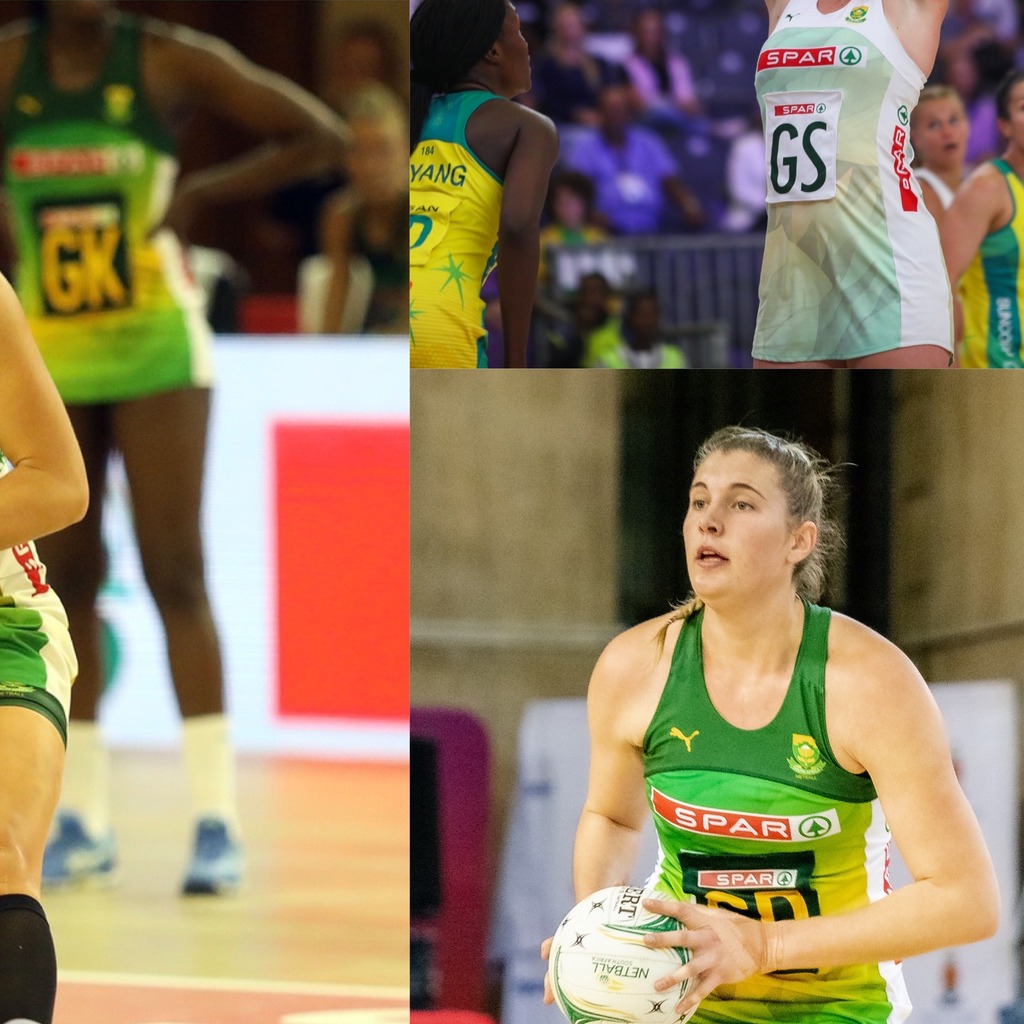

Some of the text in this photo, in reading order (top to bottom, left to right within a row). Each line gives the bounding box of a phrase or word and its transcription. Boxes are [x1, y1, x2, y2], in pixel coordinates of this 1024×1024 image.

[766, 49, 834, 65] SPAR
[782, 105, 814, 115] SPAR
[421, 146, 435, 156] 184
[770, 121, 827, 195] GS
[410, 163, 467, 188] YANG
[41, 226, 125, 311] GK
[675, 807, 789, 838] SPAR
[716, 873, 773, 886] SPAR
[591, 962, 650, 979] NETBALL
